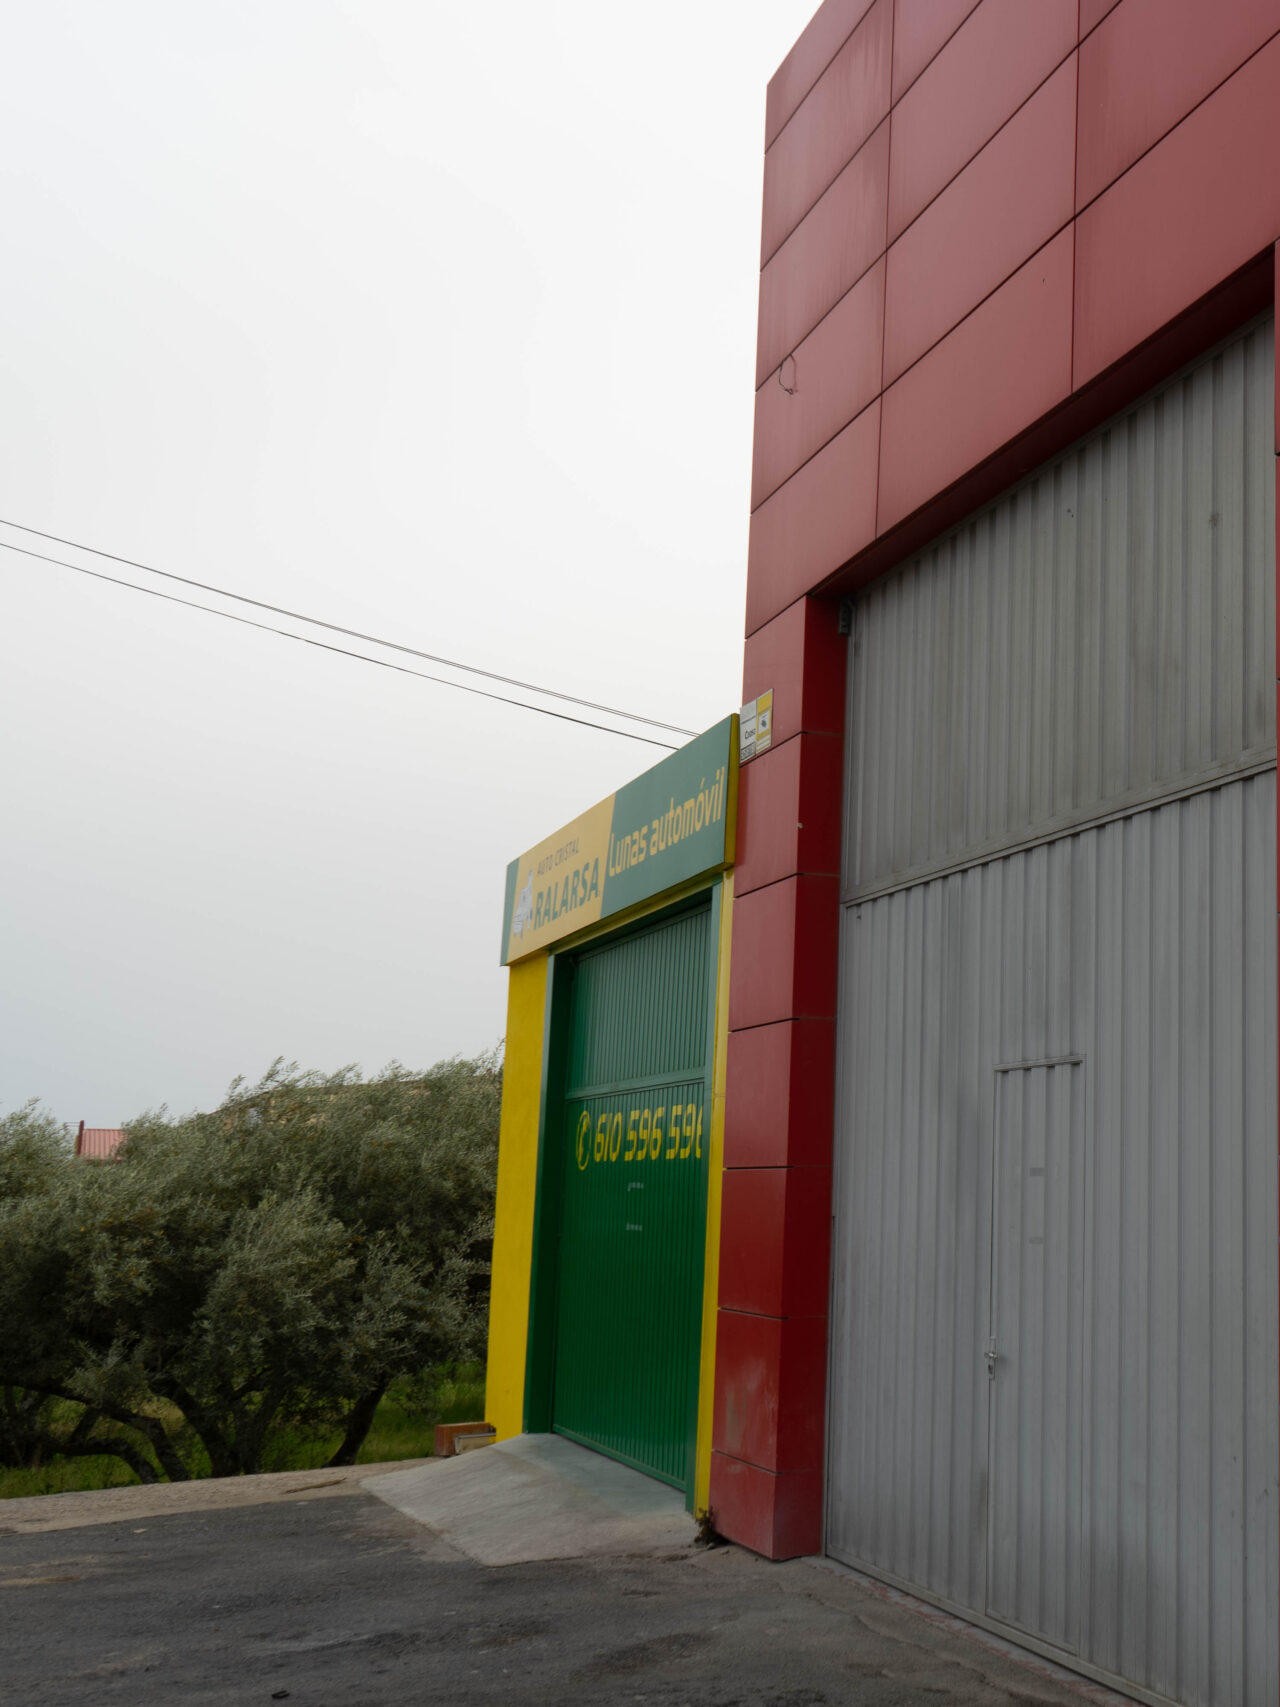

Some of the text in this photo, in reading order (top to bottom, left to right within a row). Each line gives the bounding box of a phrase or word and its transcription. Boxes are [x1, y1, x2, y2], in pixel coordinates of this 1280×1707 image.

[608, 765, 725, 878] Lunas automóvil
[537, 837, 580, 876] AUTO CRISTAL
[533, 857, 600, 931] RALARSA
[594, 1111, 623, 1163] 610
[624, 1106, 666, 1162] 596
